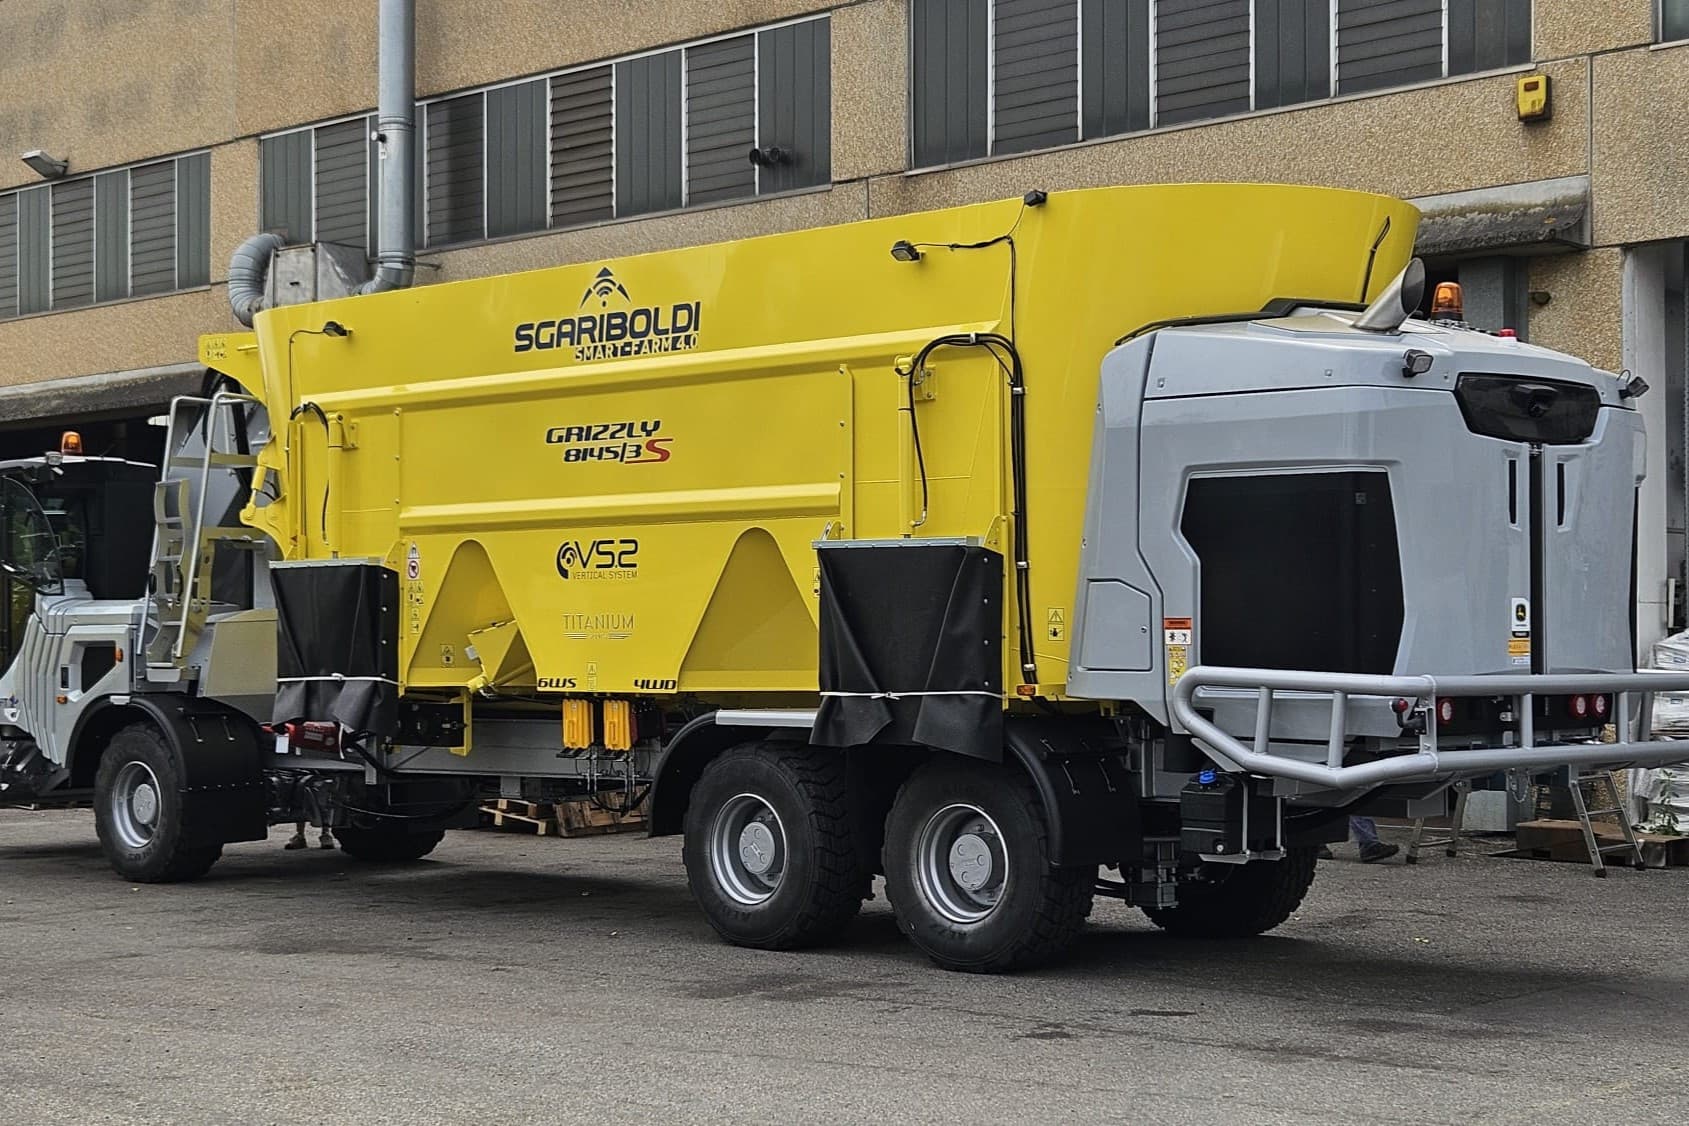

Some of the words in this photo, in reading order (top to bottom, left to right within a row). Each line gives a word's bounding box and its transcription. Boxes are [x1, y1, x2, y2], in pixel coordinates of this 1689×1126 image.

[514, 301, 701, 353] SGARIBOLDI
[675, 333, 698, 350] 4.0
[546, 420, 661, 444] GRIZZLY
[572, 571, 606, 580] VERTICAL
[609, 570, 638, 580] SYSTEM
[562, 613, 634, 630] TITANIUM
[537, 677, 577, 689] 6WS
[634, 679, 678, 690] 4WD
